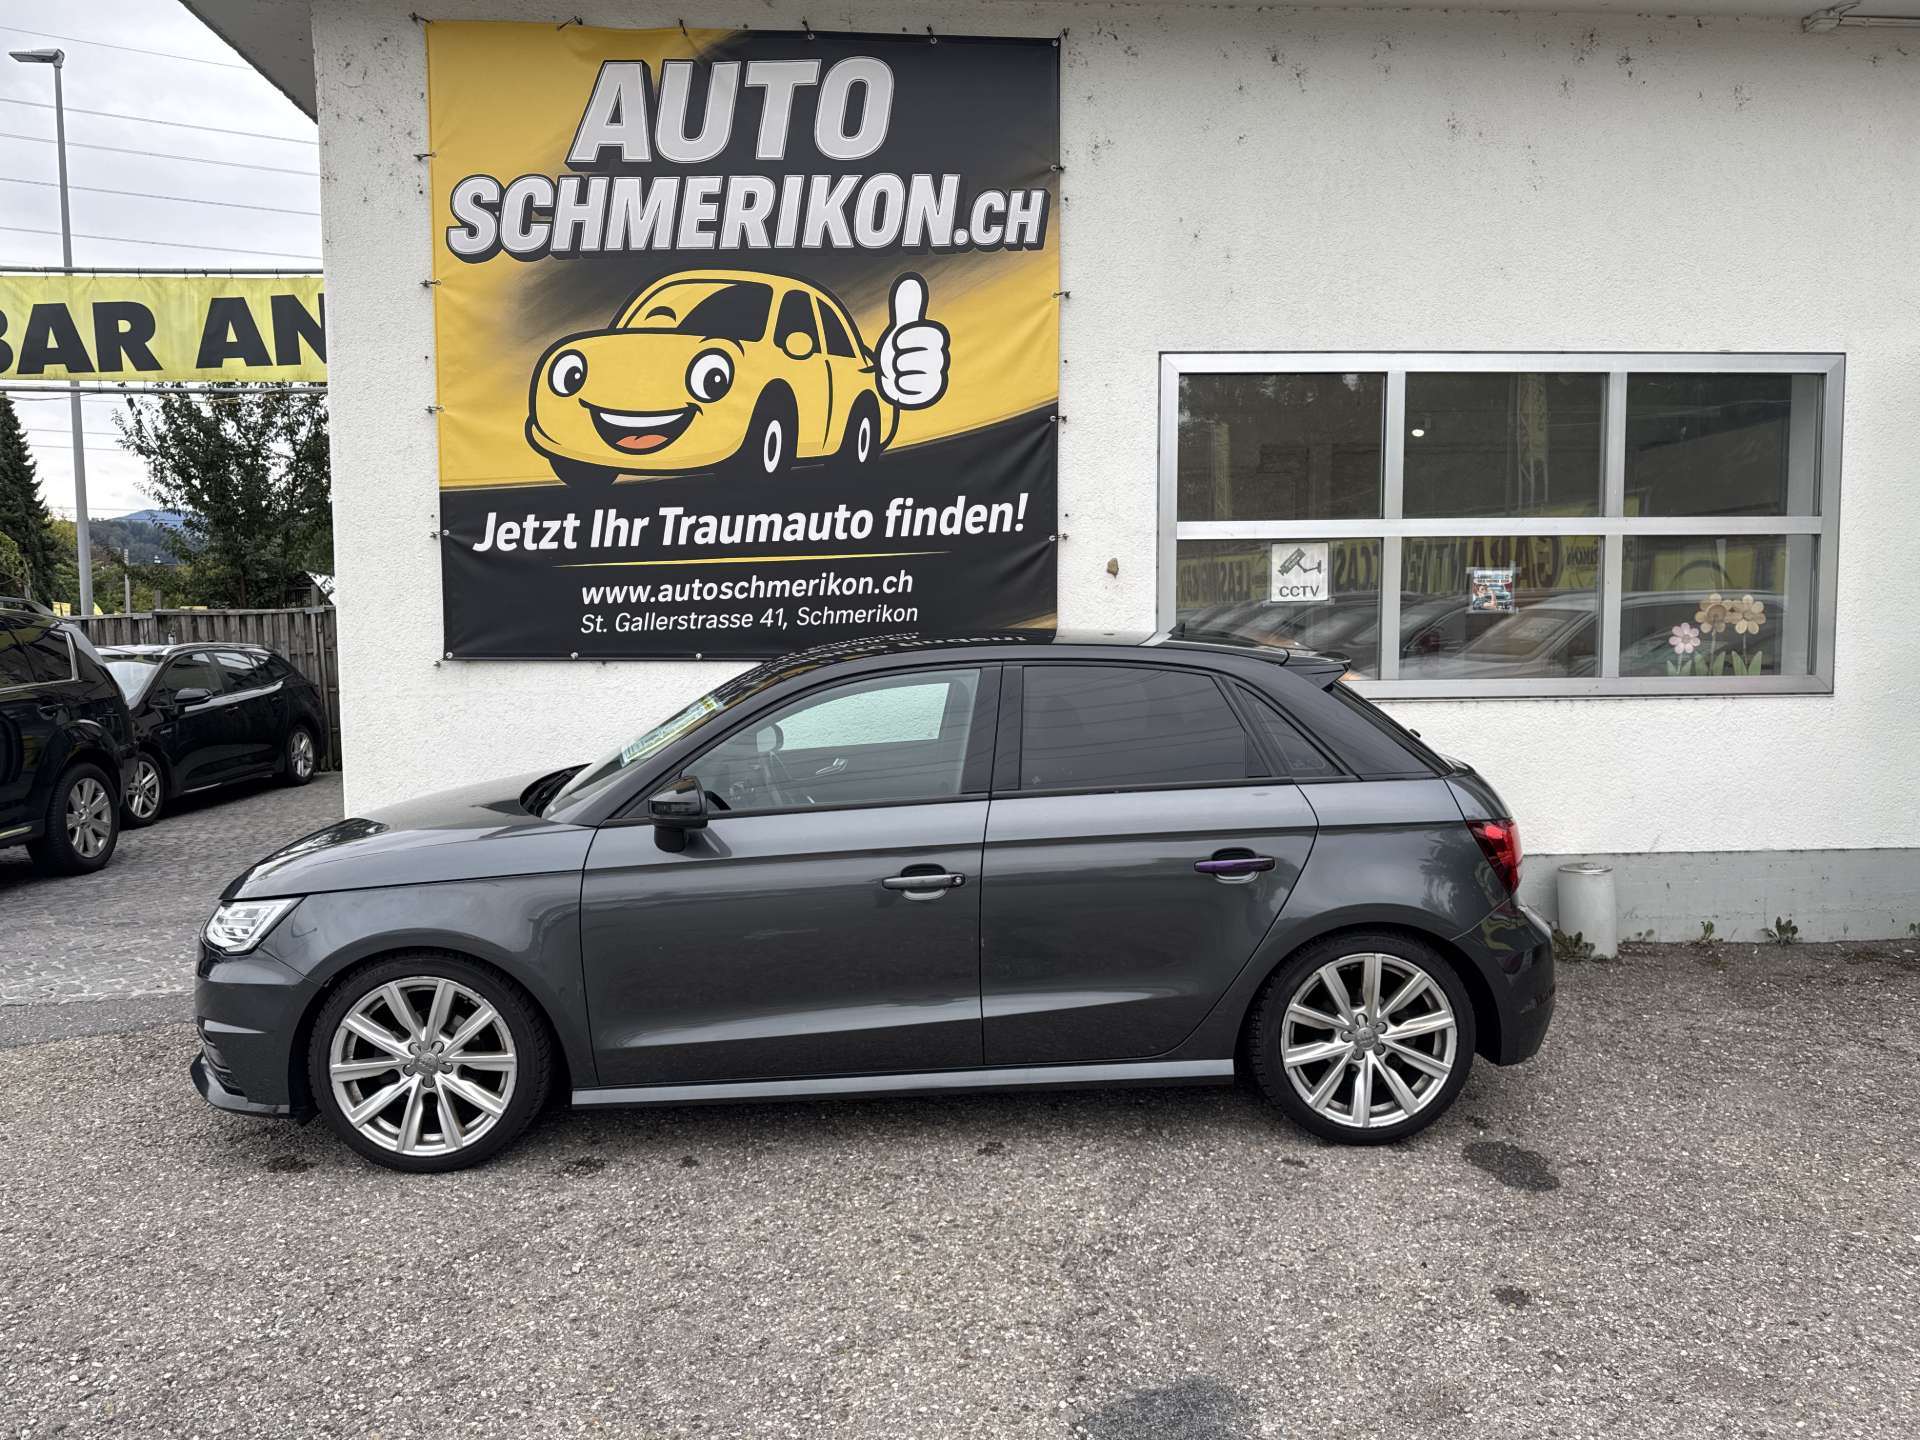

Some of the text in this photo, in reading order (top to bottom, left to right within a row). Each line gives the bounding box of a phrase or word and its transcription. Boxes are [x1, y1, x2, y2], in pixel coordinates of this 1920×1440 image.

[565, 55, 894, 165] AUTO
[446, 172, 1048, 257] SCHMERIKON.CH
[0, 301, 163, 375] AR
[472, 492, 1029, 552] Jetzt Ihr Traumauto finden!
[581, 569, 914, 605] www.autoschmerikon.ch
[1279, 585, 1320, 598] CCTV
[580, 604, 918, 634] St. Gallerstrasse 41, Schmerikon
